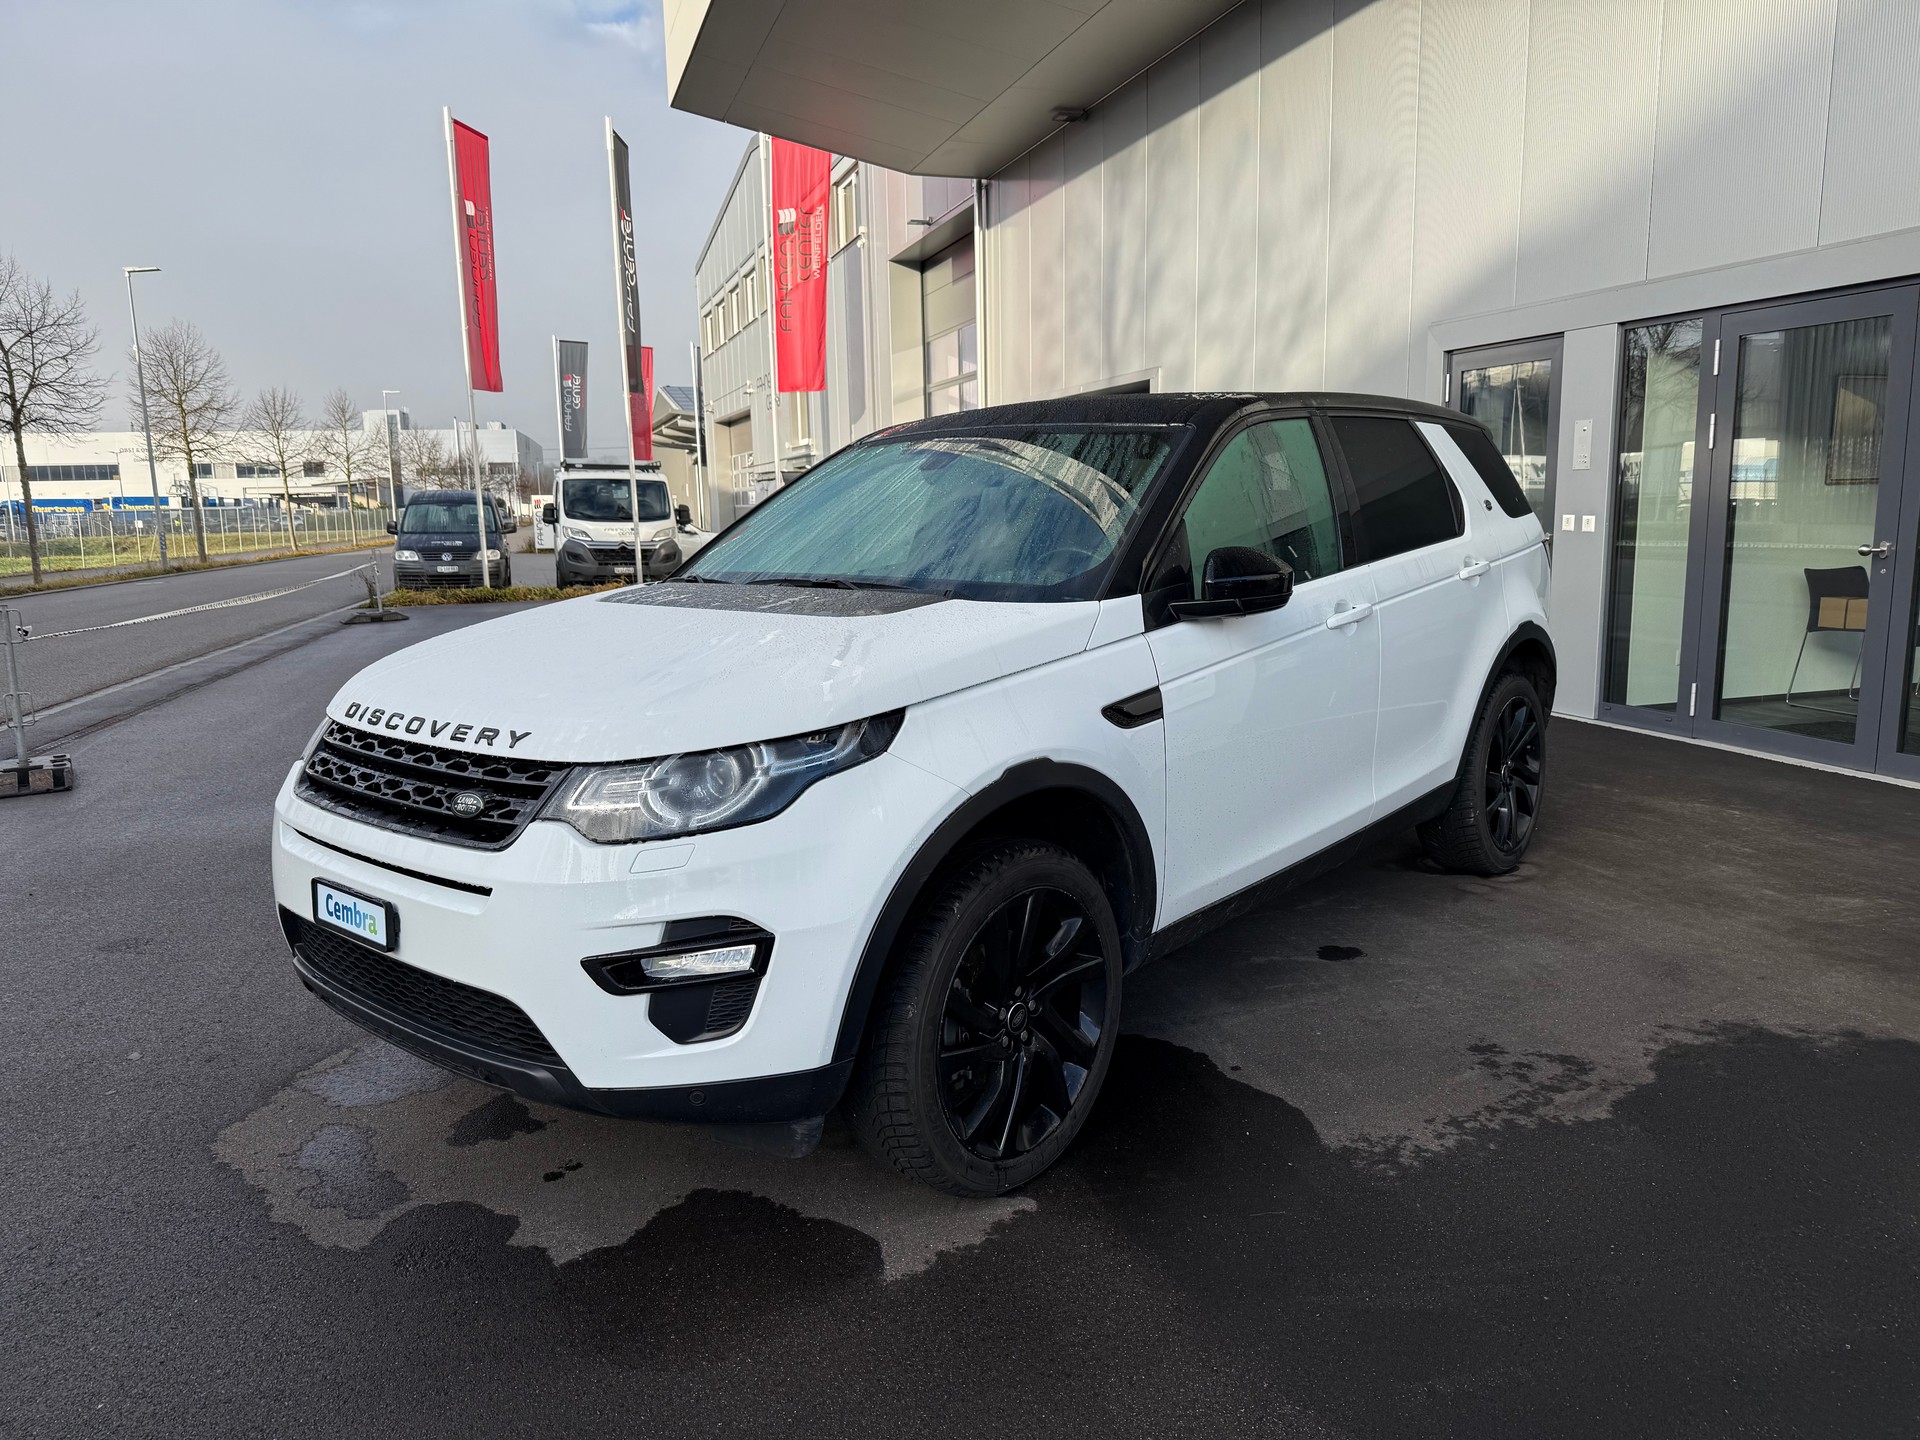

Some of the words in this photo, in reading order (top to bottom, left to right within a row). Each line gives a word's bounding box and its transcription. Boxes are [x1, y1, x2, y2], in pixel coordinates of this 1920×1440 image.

[813, 205, 824, 280] WEINFELDEN
[563, 388, 572, 432] FAHNEN
[572, 373, 581, 410] CENTER
[344, 701, 532, 749] DISCOVERY
[457, 796, 474, 805] LAND
[457, 803, 477, 813] ROVER
[325, 893, 378, 936] Cembra
